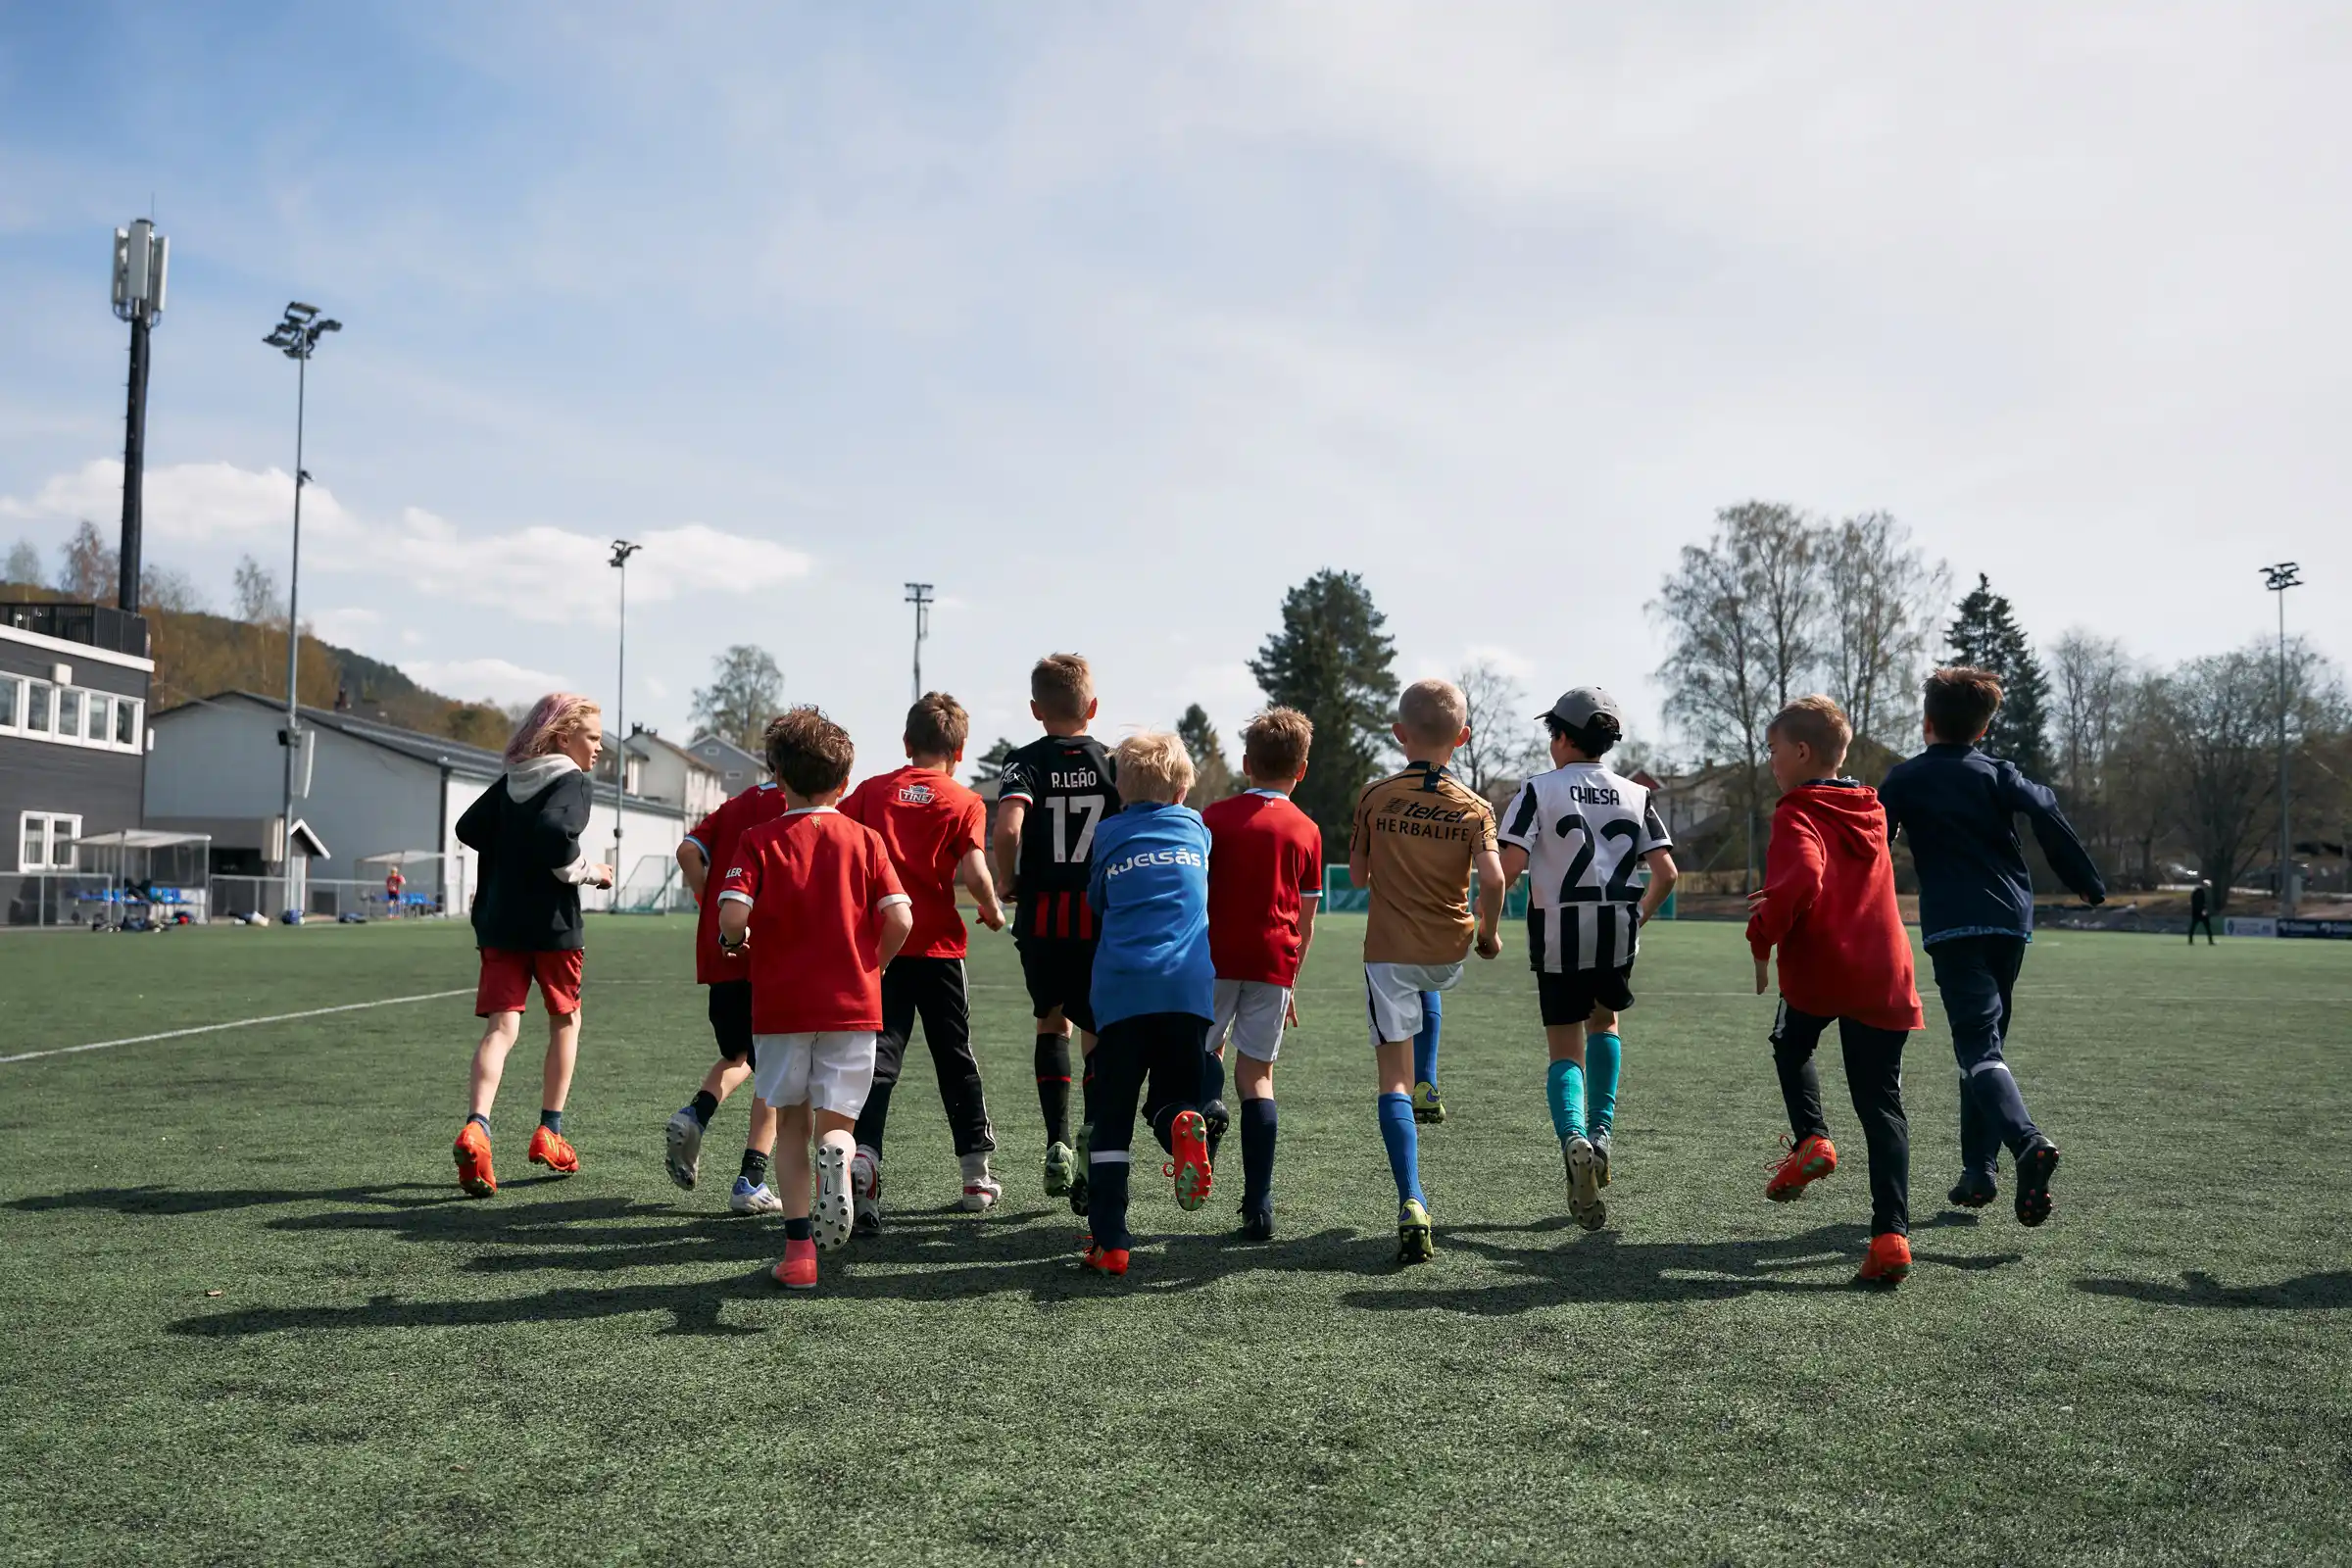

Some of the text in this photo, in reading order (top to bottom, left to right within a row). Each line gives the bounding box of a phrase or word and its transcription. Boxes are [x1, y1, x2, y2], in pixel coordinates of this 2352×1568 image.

[1052, 767, 1098, 788] R.LEÃO
[904, 791, 929, 802] TINE
[1570, 785, 1620, 806] CHIESA
[1403, 801, 1469, 824] telcel
[1045, 795, 1105, 863] 17
[1376, 817, 1470, 843] HERBALIFE
[1555, 813, 1645, 904] 22
[725, 866, 743, 879] LER
